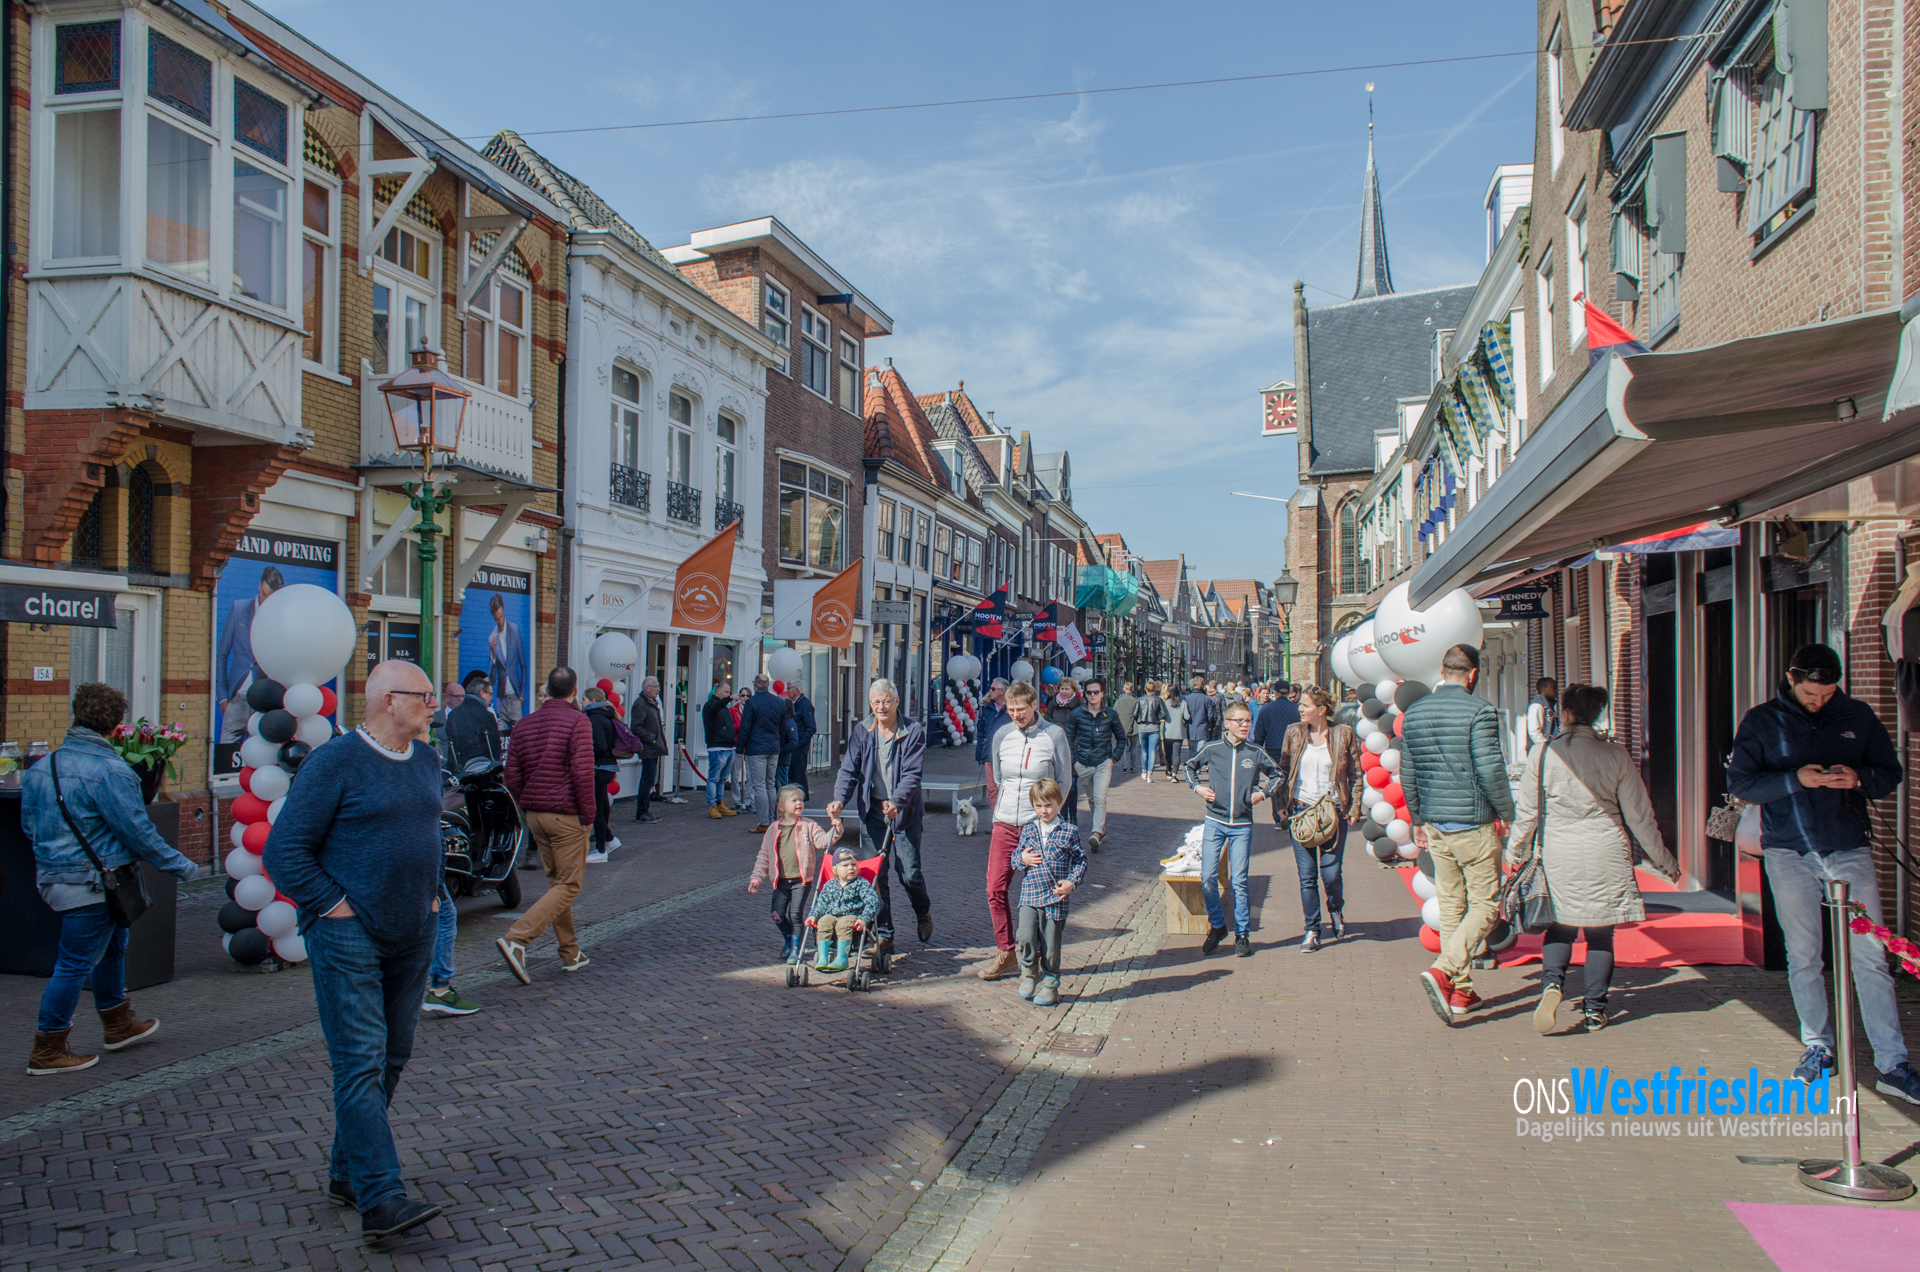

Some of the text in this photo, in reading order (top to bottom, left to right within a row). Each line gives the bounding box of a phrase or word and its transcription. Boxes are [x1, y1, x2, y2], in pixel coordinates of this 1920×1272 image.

[273, 540, 332, 563] OPENING
[490, 572, 527, 590] OPENING
[24, 592, 100, 619] charel
[602, 593, 625, 608] BOSS
[1500, 592, 1543, 601] KENNEDY
[1063, 631, 1083, 656] SINGER
[37, 668, 50, 680] 15A
